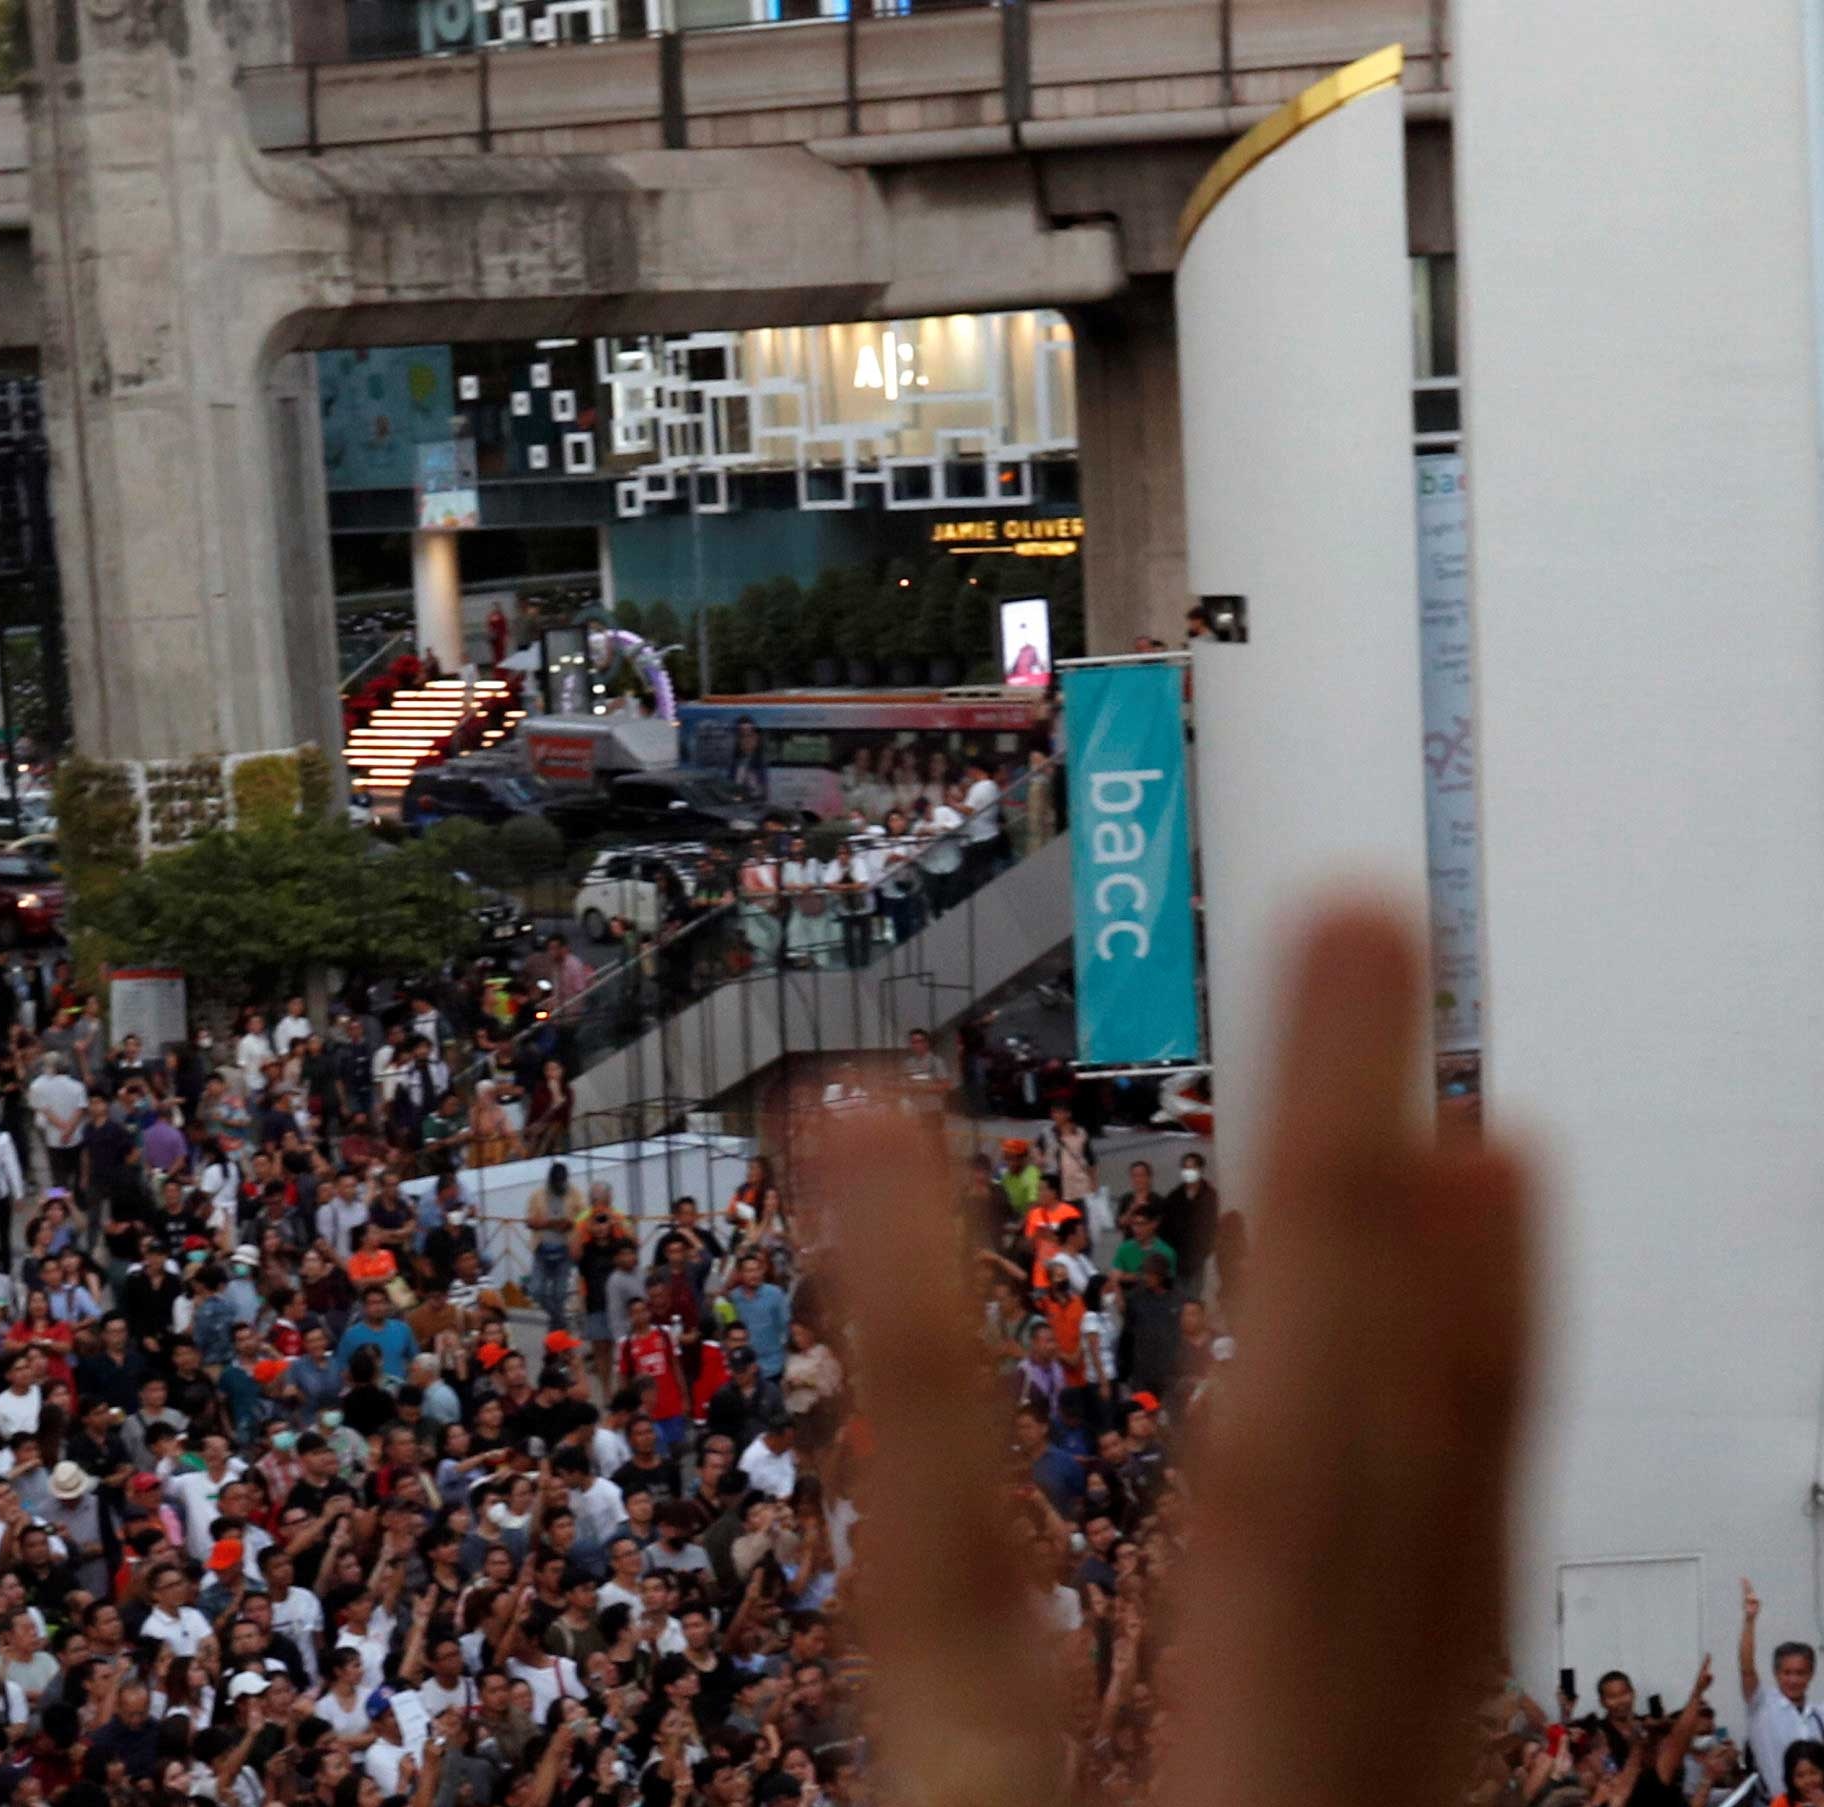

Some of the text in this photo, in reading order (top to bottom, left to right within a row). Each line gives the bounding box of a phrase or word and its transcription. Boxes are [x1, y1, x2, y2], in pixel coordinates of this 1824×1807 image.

[933, 517, 1086, 542] JAMIE OLIVER
[1090, 768, 1164, 961] bacc
